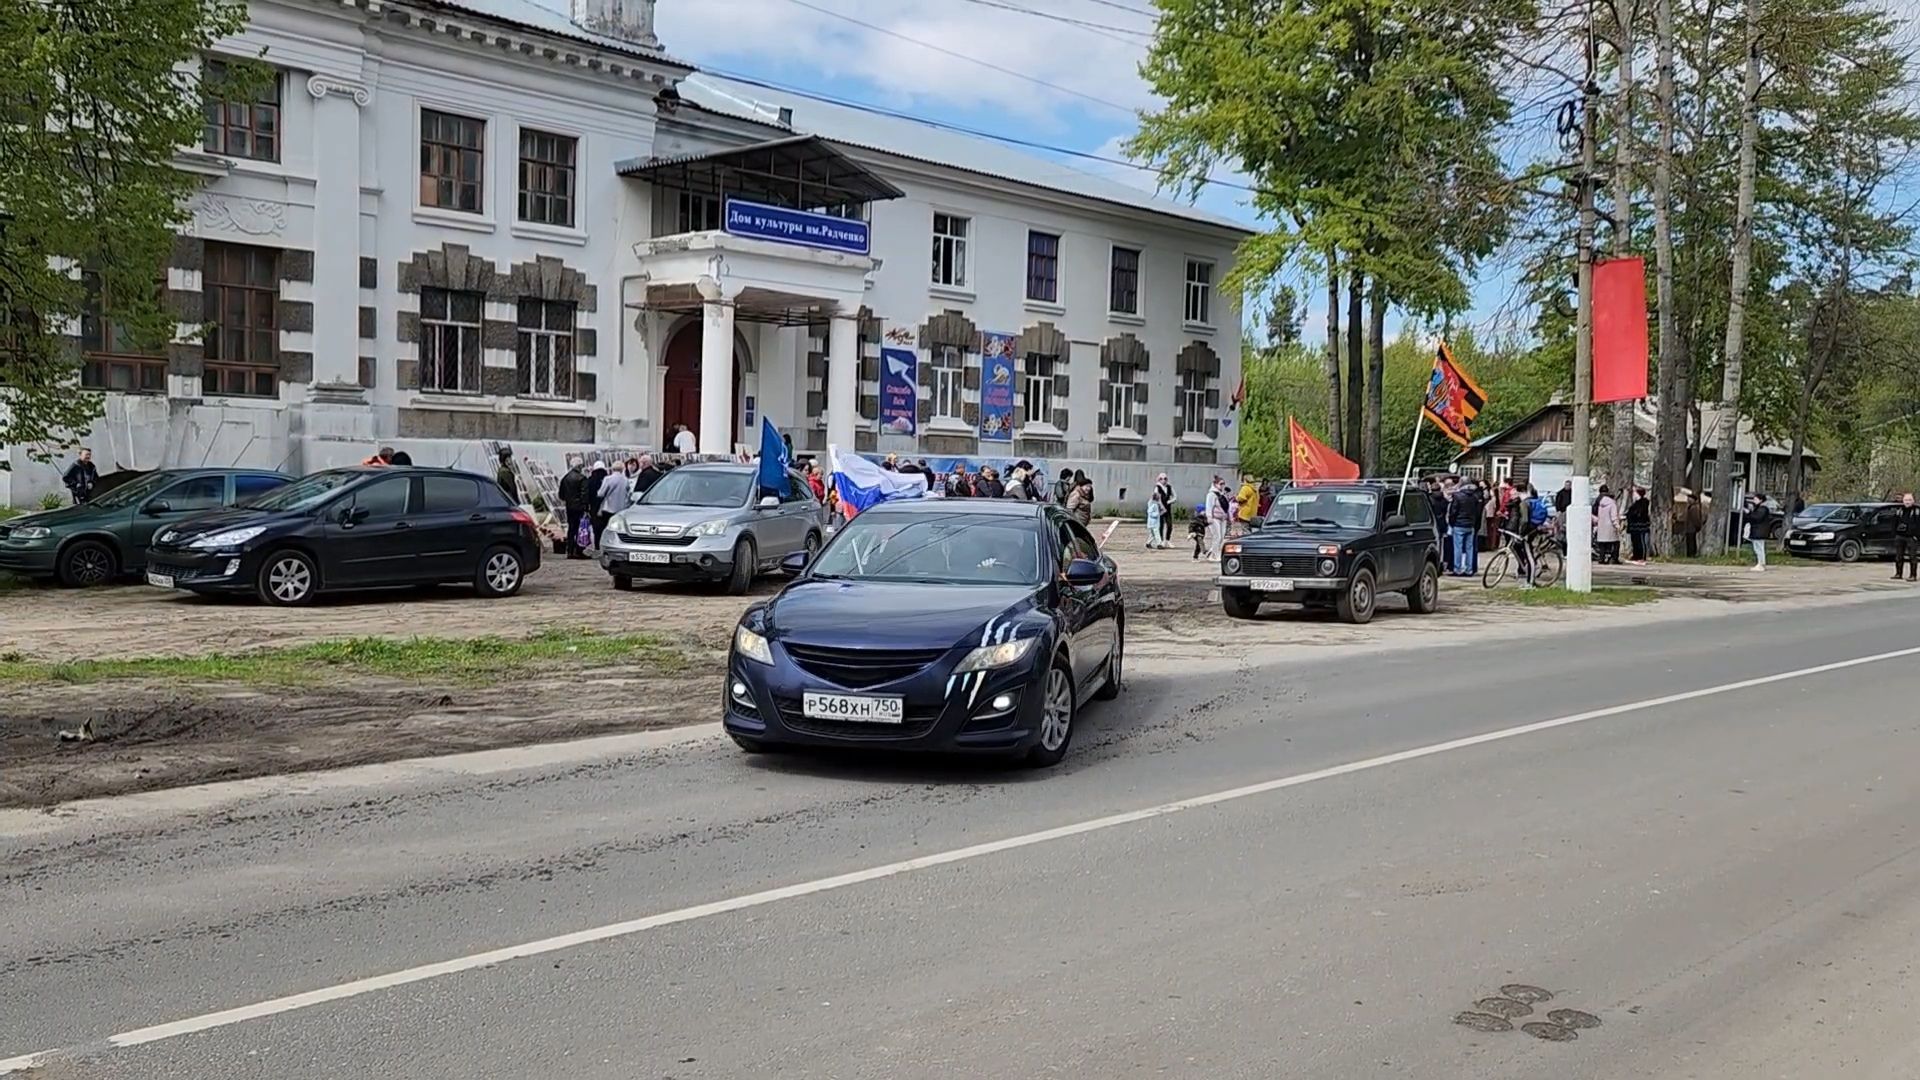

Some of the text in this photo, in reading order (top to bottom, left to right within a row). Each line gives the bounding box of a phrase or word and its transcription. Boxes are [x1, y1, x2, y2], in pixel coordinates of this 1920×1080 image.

[729, 210, 752, 225] Дом
[754, 216, 803, 234] культуры
[808, 697, 898, 716] Р568ХН 750
